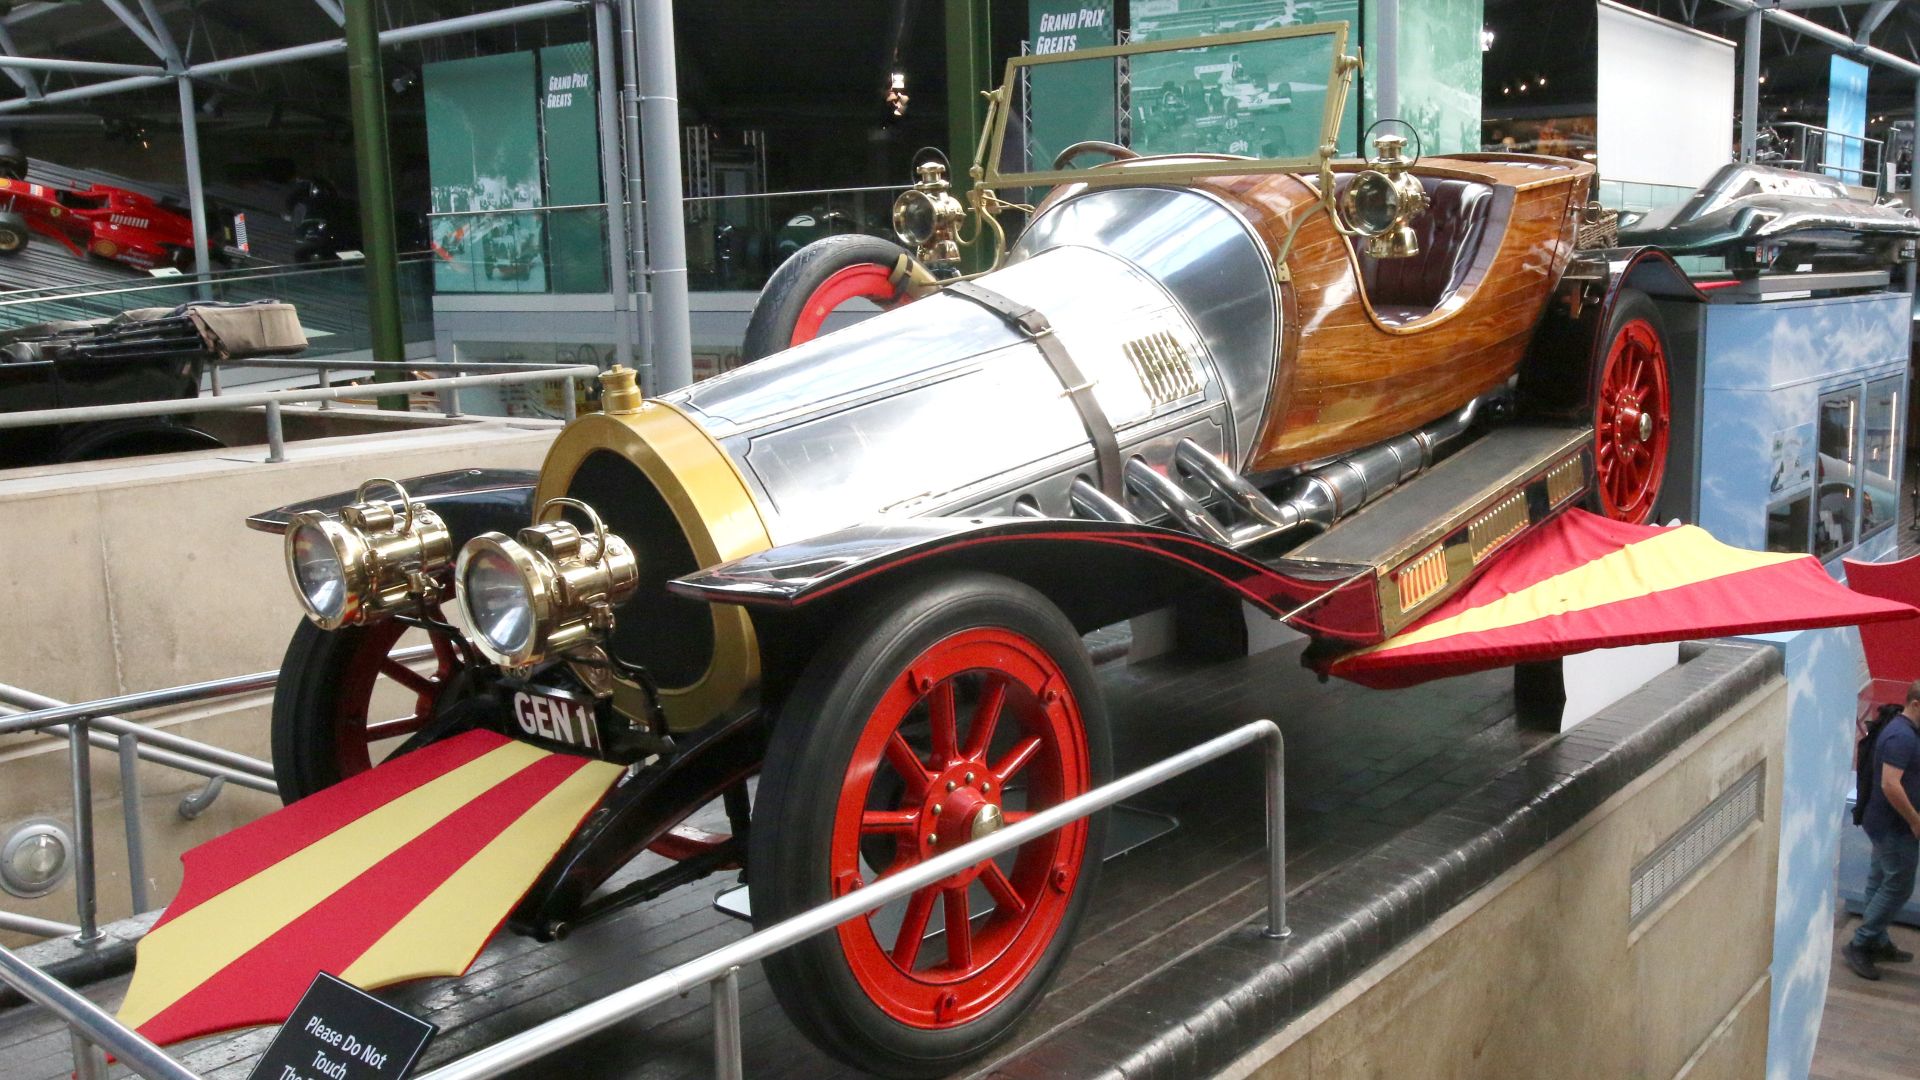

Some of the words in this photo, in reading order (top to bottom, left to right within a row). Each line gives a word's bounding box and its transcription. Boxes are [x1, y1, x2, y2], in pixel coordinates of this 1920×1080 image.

[1040, 13, 1077, 32] GRAND
[1077, 9, 1105, 28] PRIX
[1036, 35, 1077, 55] GREATS
[549, 75, 571, 91] GRAND
[572, 73, 588, 88] PRIX
[547, 93, 572, 108] GREATS
[514, 691, 575, 744] GEN
[304, 1015, 343, 1047] Please
[341, 1034, 361, 1056] Do
[360, 1044, 387, 1070] Not
[279, 1064, 302, 1080] Th
[311, 1050, 348, 1080] Touch
